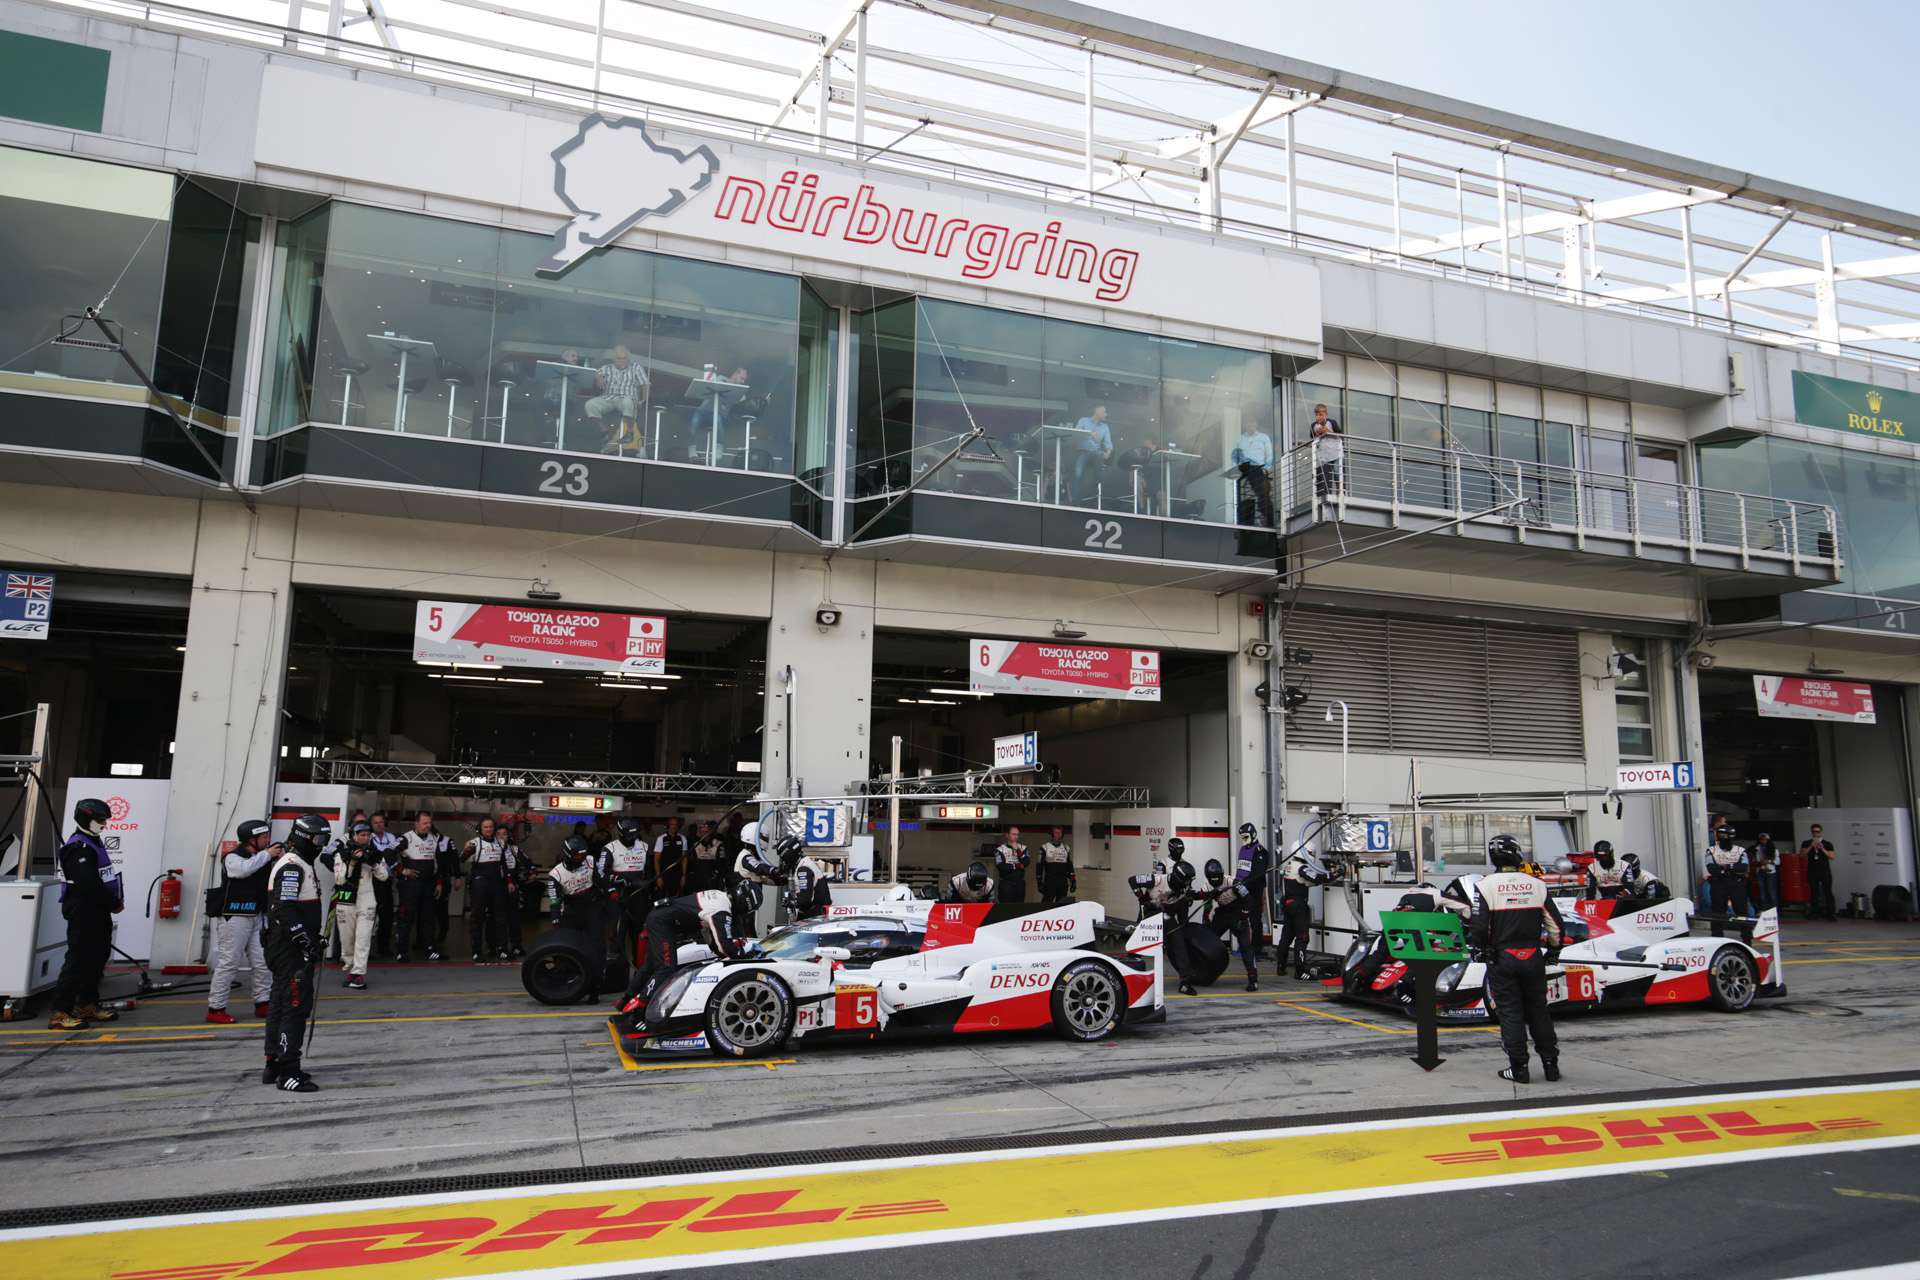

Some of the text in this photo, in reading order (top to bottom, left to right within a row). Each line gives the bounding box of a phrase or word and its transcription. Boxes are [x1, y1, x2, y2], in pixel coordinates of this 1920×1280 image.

[715, 171, 1139, 301] nürburgring
[1848, 414, 1905, 437] ROLEX
[539, 461, 589, 496] 23
[1085, 519, 1122, 549] 22
[28, 603, 46, 616] P2
[429, 607, 443, 632] 5
[507, 611, 600, 627] TOYOTA GAZOO
[1884, 606, 1906, 630] 21
[532, 624, 576, 637] RACING
[509, 635, 540, 644] TOYOTA
[542, 638, 564, 646] TS050
[569, 639, 598, 648] HYBRID
[629, 642, 642, 652] P1
[646, 643, 661, 653] HY
[980, 645, 990, 667] 6
[1038, 648, 1109, 660] TOYOTA GAZOO
[1058, 659, 1091, 669] RACING
[1132, 672, 1142, 682] P1
[1145, 673, 1157, 683] HY
[1761, 680, 1768, 696] 4
[1801, 689, 1838, 698] RACING TEAM
[997, 736, 1033, 763] TOYOTA 5
[1620, 764, 1690, 787] TOYOTA 6
[551, 797, 558, 806] 5
[596, 799, 602, 808] 5
[940, 807, 946, 816] 6
[976, 807, 982, 816] 6
[500, 814, 596, 824] TOYOTA HYBRID
[813, 809, 829, 838] 5
[877, 822, 920, 830] HYRID
[1146, 828, 1164, 836] DENSO
[1373, 824, 1385, 848] 6
[101, 867, 112, 878] PIT
[1498, 883, 1532, 892] DENSO
[339, 891, 352, 899] TV
[229, 902, 256, 910] PIT LANE
[1585, 904, 1595, 914] HY
[946, 908, 961, 920] HY
[1637, 912, 1674, 924] DENSO
[1020, 919, 1075, 932] DENSO
[990, 973, 1050, 988] DENSO
[1581, 974, 1592, 997] 6
[856, 996, 873, 1024] 5
[799, 1011, 813, 1025] P1
[1467, 1110, 1820, 1160] DHL
[234, 1189, 850, 1278] DHL
